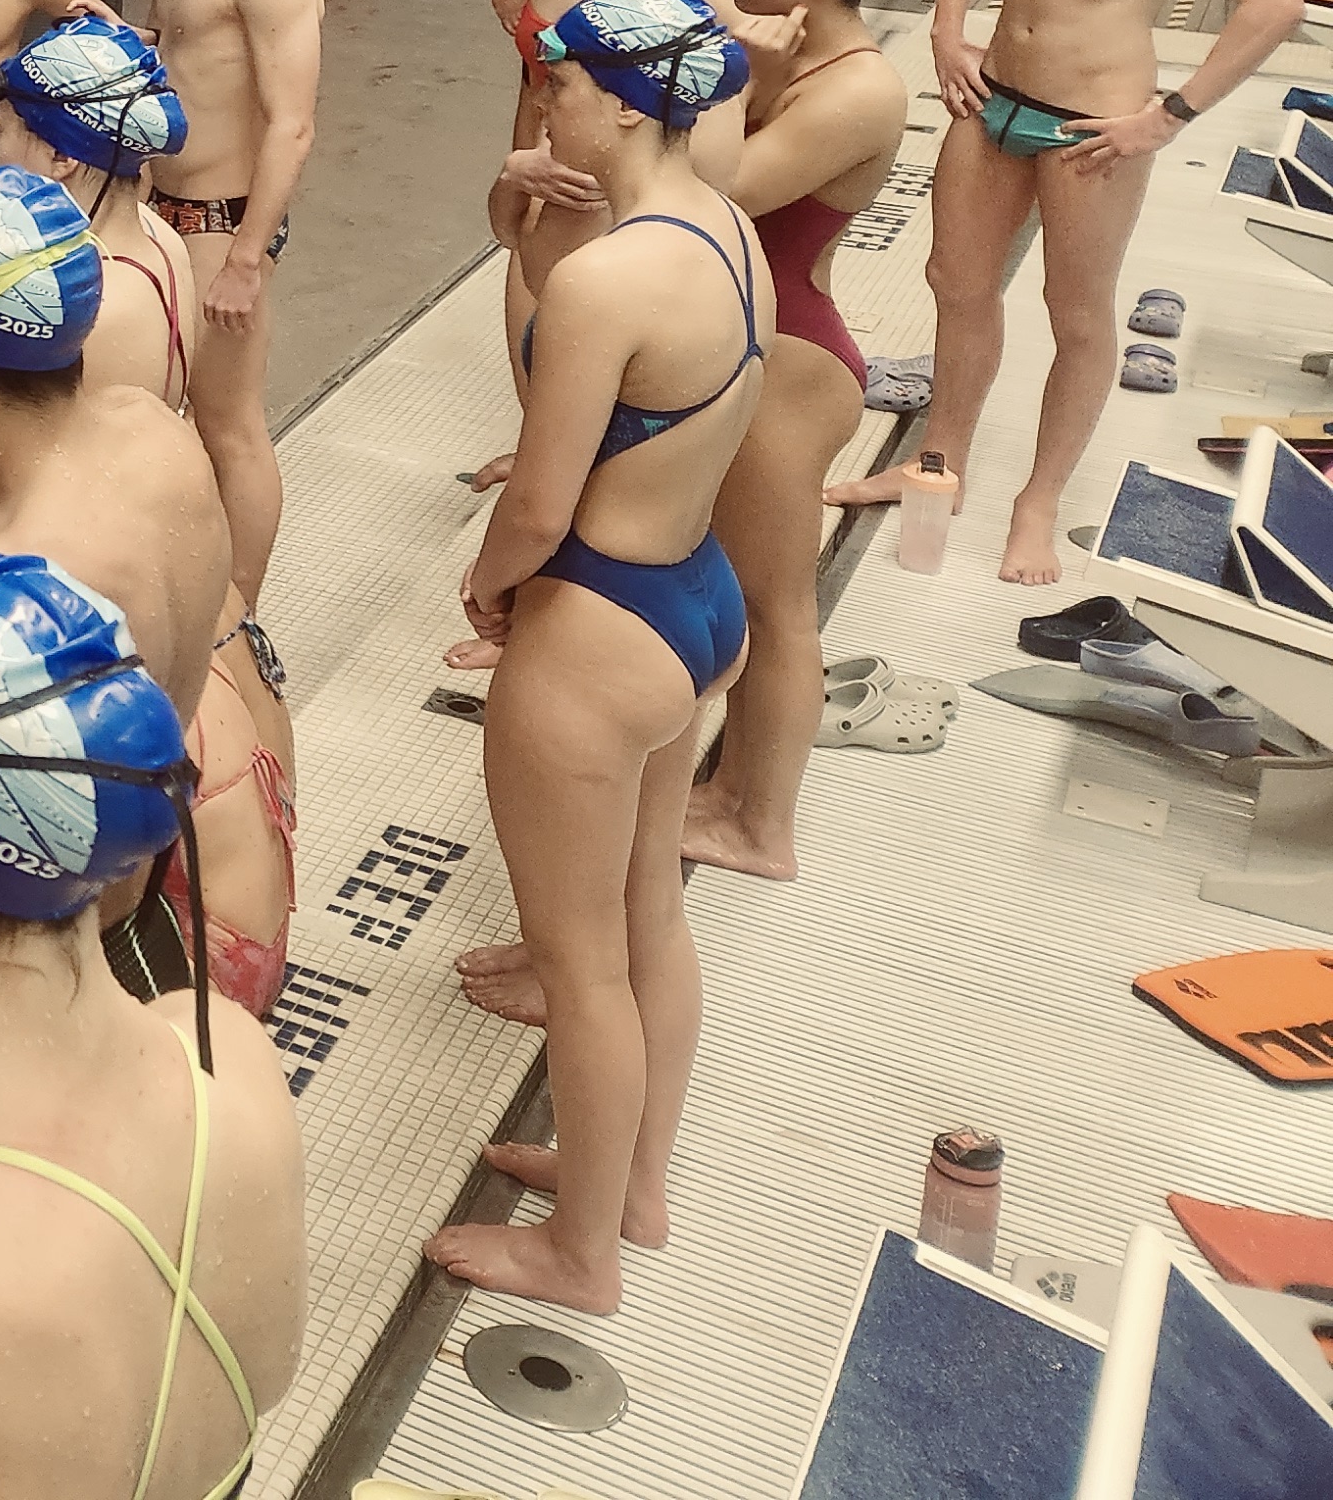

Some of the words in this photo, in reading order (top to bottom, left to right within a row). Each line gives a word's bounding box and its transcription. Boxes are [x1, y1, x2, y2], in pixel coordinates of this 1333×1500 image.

[580, 0, 619, 47] USOPTC
[21, 54, 64, 98] USOPTC
[63, 102, 110, 132] CAMP
[326, 825, 470, 951] DEEP
